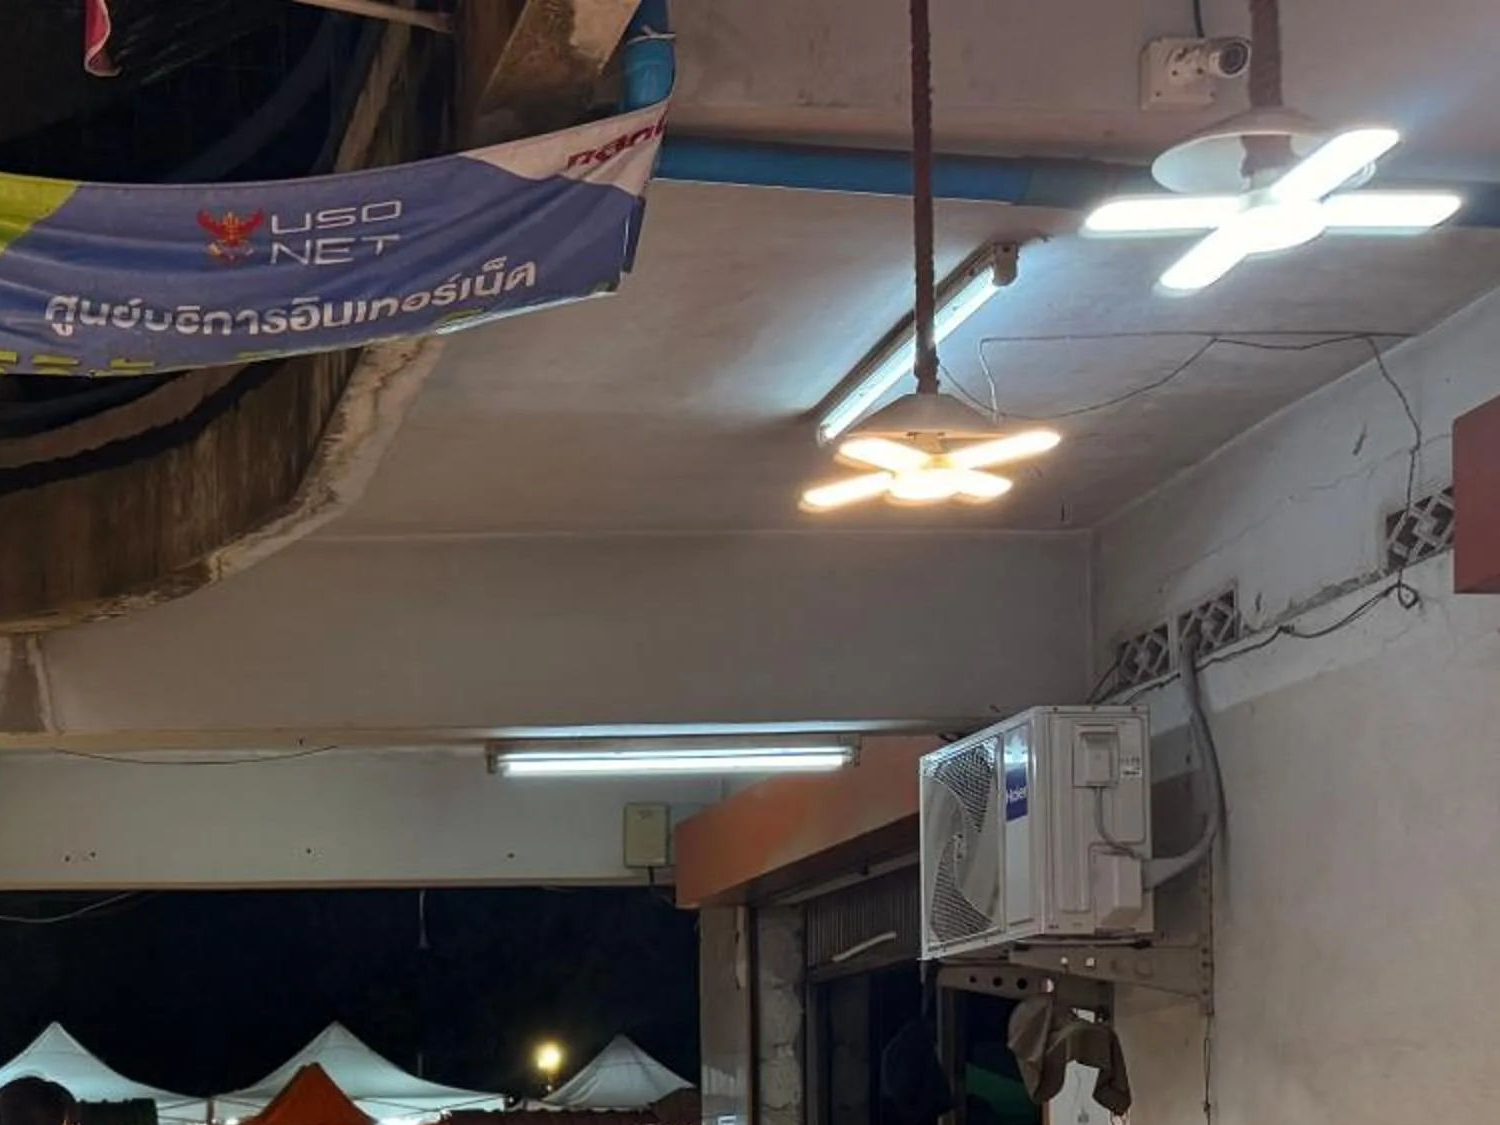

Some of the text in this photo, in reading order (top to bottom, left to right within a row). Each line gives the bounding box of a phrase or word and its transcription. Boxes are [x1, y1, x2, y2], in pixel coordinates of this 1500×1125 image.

[271, 200, 402, 234] USO
[270, 234, 401, 266] NET
[44, 255, 537, 337] ศูนย์บริการอินเทอร์เน็ต
